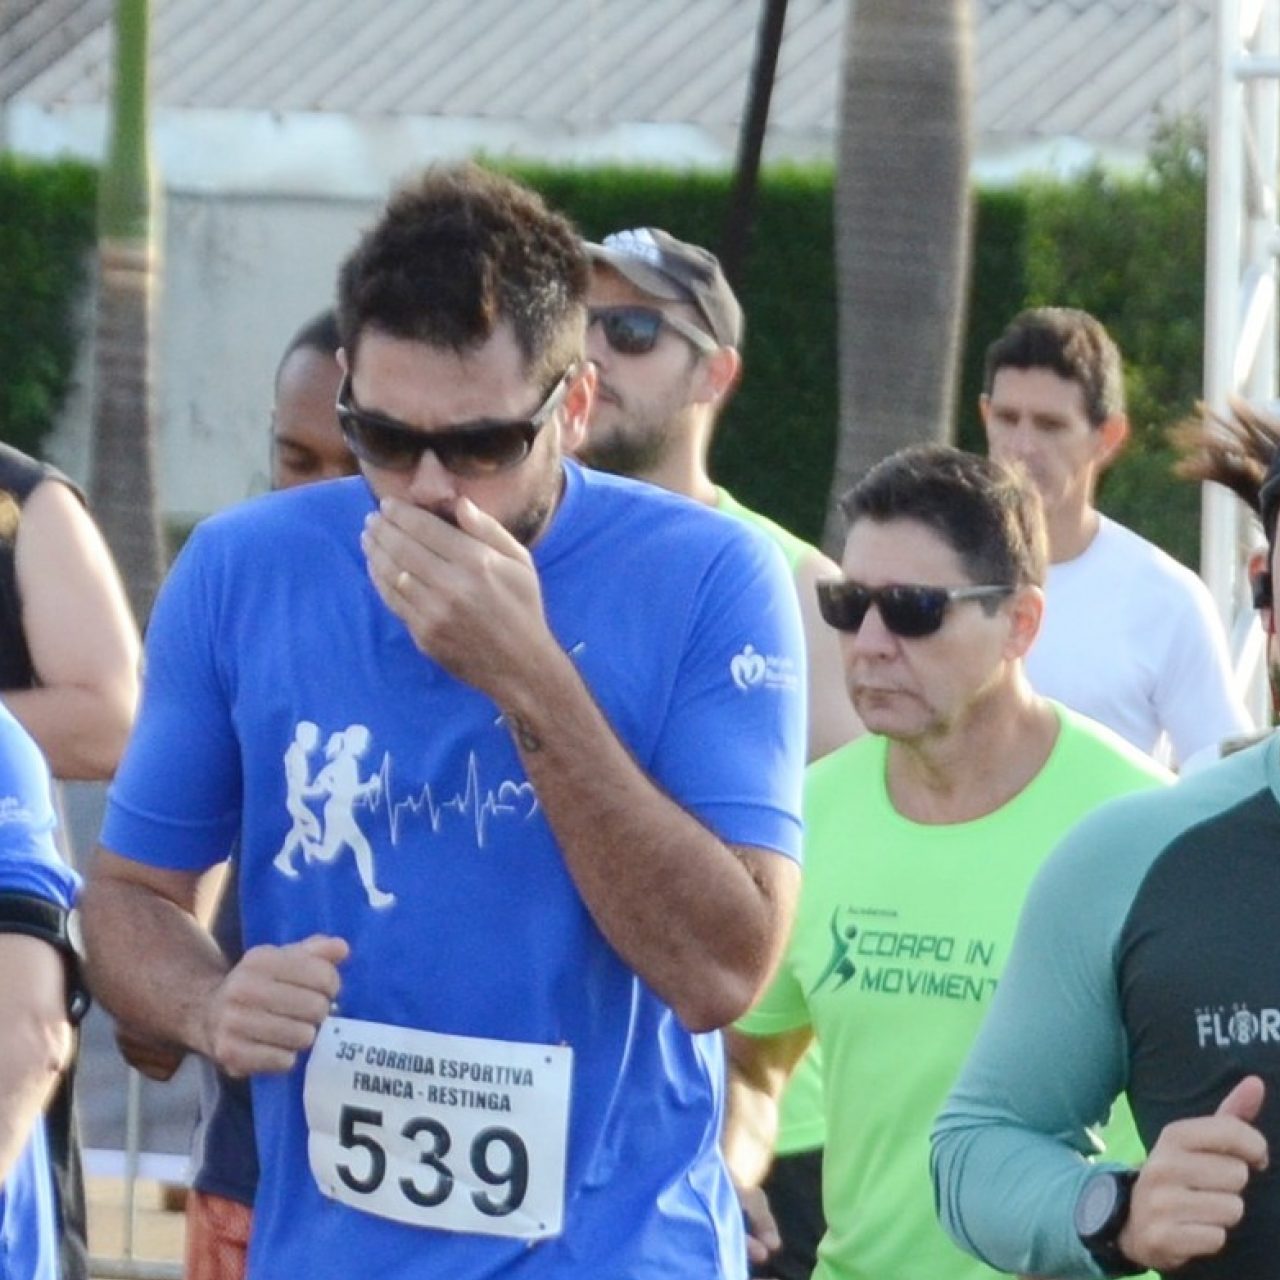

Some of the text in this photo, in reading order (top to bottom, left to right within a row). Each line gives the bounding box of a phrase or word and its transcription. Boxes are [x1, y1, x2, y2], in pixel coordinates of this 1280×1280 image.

[856, 930, 995, 967] CORPO IN
[365, 1046, 435, 1076] CORRIDA
[439, 1059, 534, 1087] ESPORTIVA
[353, 1071, 414, 1100] FRANCA
[427, 1084, 512, 1112] RESTINGA
[335, 1103, 529, 1218] 539
